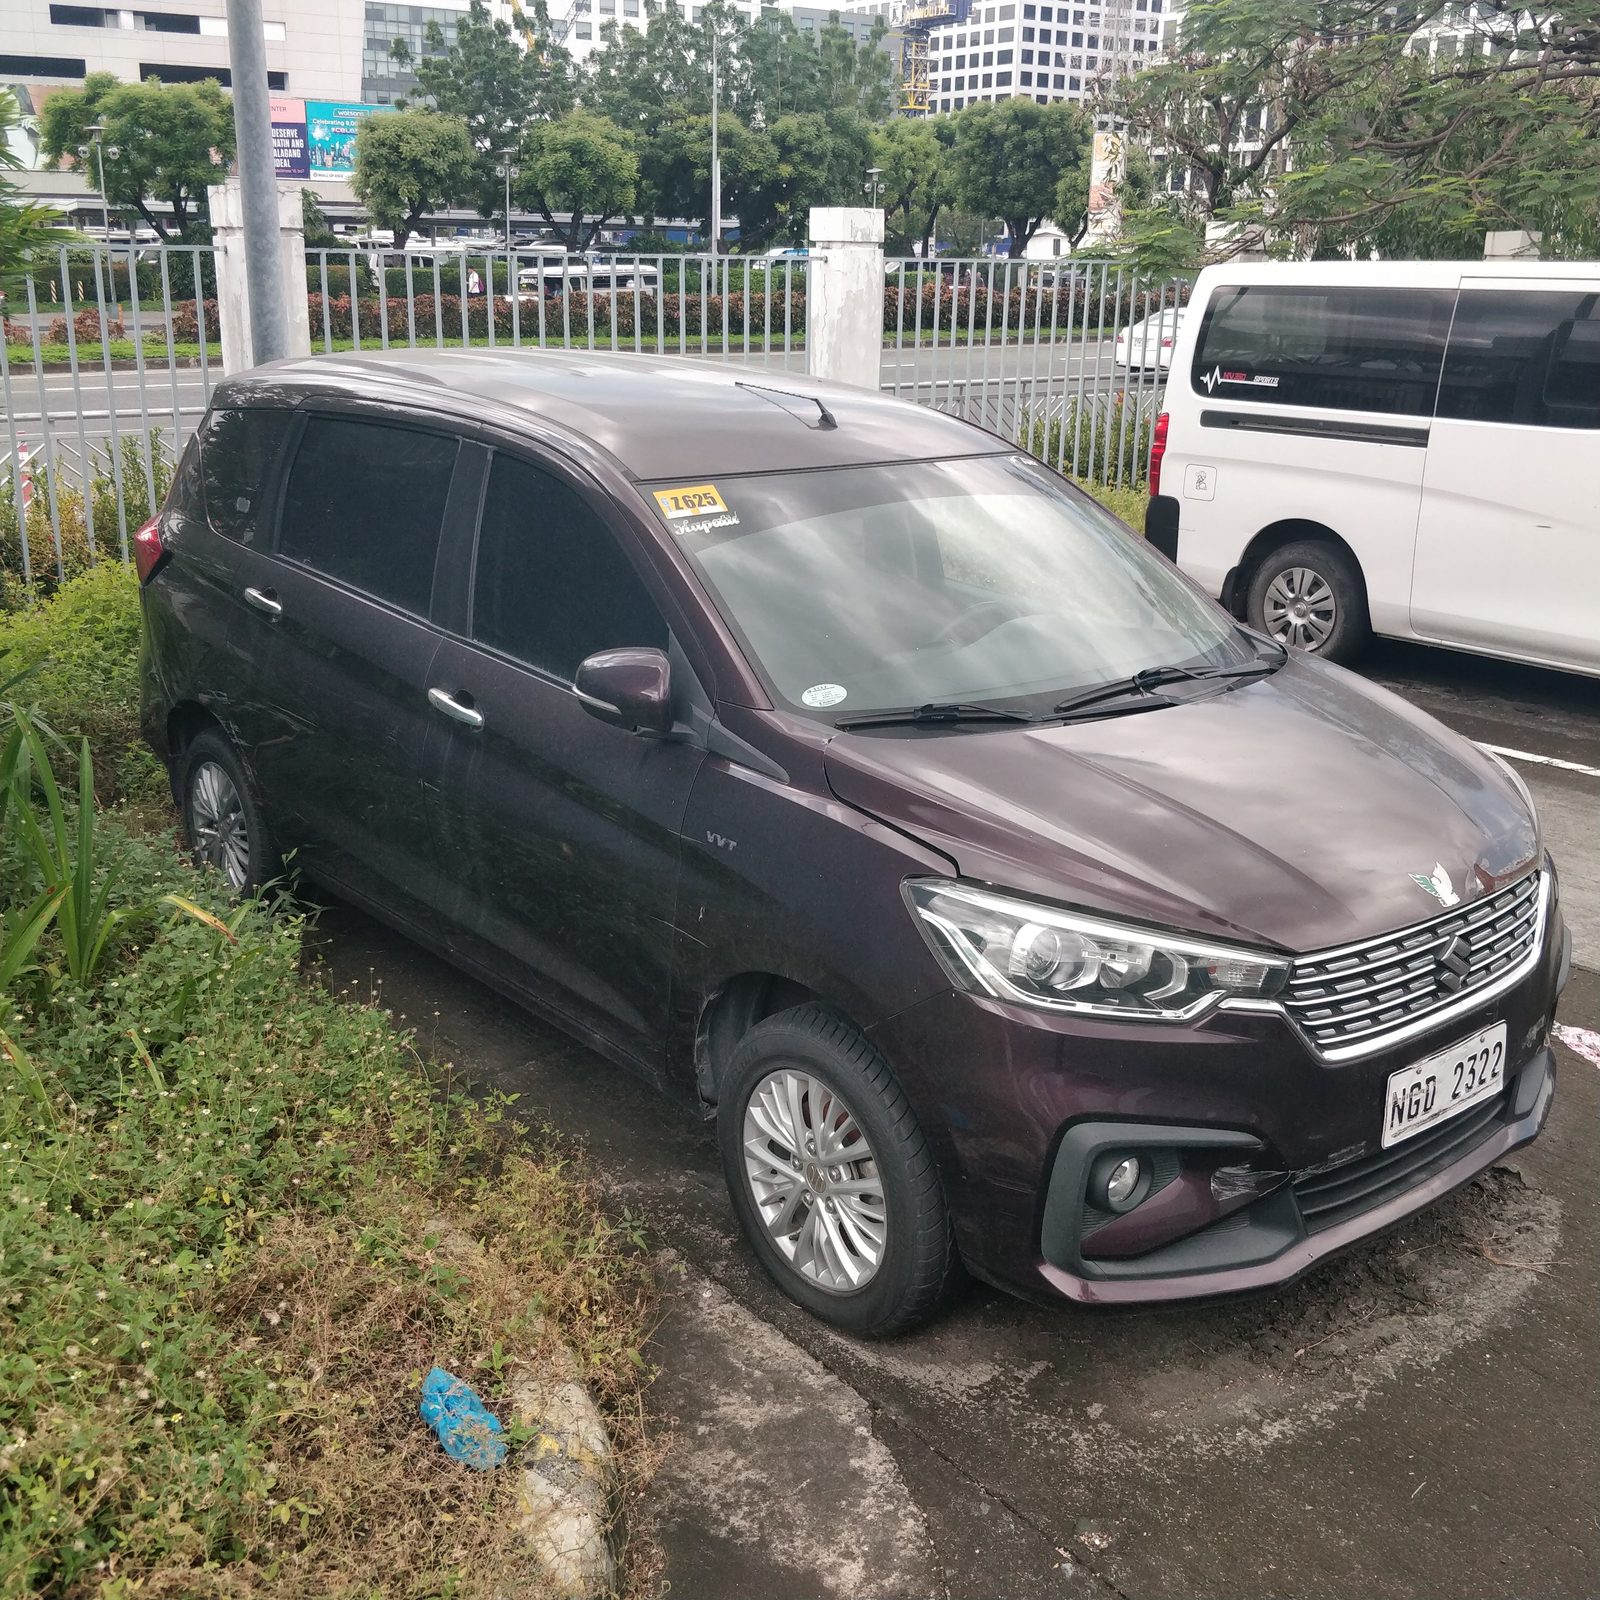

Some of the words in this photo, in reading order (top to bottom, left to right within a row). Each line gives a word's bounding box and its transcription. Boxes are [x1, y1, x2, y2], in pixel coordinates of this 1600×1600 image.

[312, 118, 345, 126] Celebrating
[271, 128, 298, 138] DESERVE
[272, 138, 290, 148] NATIN
[291, 138, 305, 149] ANG
[273, 148, 302, 158] ALAGANG
[1253, 375, 1279, 385] SPORTS
[670, 492, 718, 511] Z625
[1389, 1075, 1437, 1130] NGD
[1451, 1040, 1503, 1100] 2322
